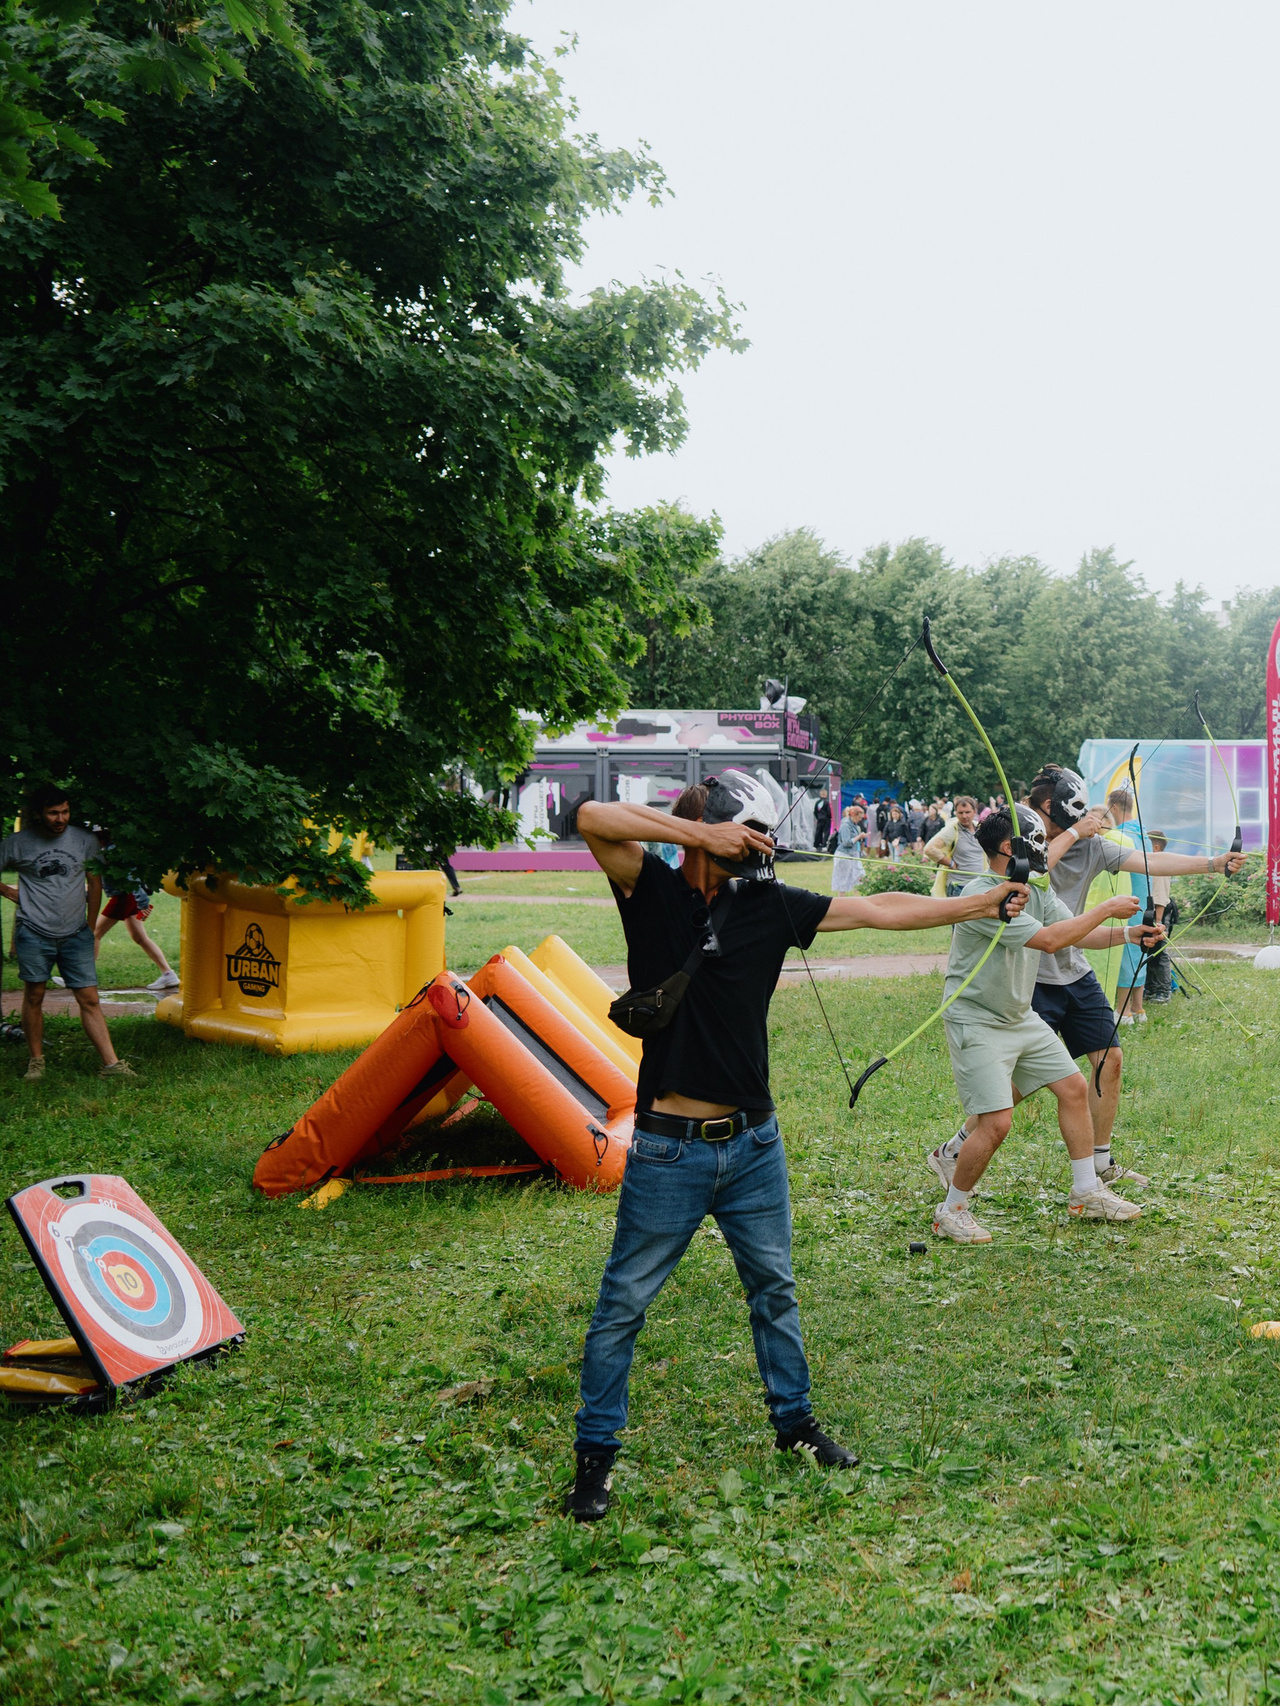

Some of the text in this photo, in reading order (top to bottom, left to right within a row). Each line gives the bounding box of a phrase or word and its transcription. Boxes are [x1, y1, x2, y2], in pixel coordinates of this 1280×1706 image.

[720, 713, 780, 721] PHYGITAL
[754, 721, 780, 729] BOX
[230, 958, 279, 987] URBAN
[242, 982, 265, 993] GAMING
[98, 1198, 118, 1210] soft
[51, 1224, 61, 1238] 6
[64, 1235, 75, 1252] 7
[82, 1248, 93, 1262] 8
[97, 1259, 107, 1273] 9
[117, 1271, 138, 1291] 10
